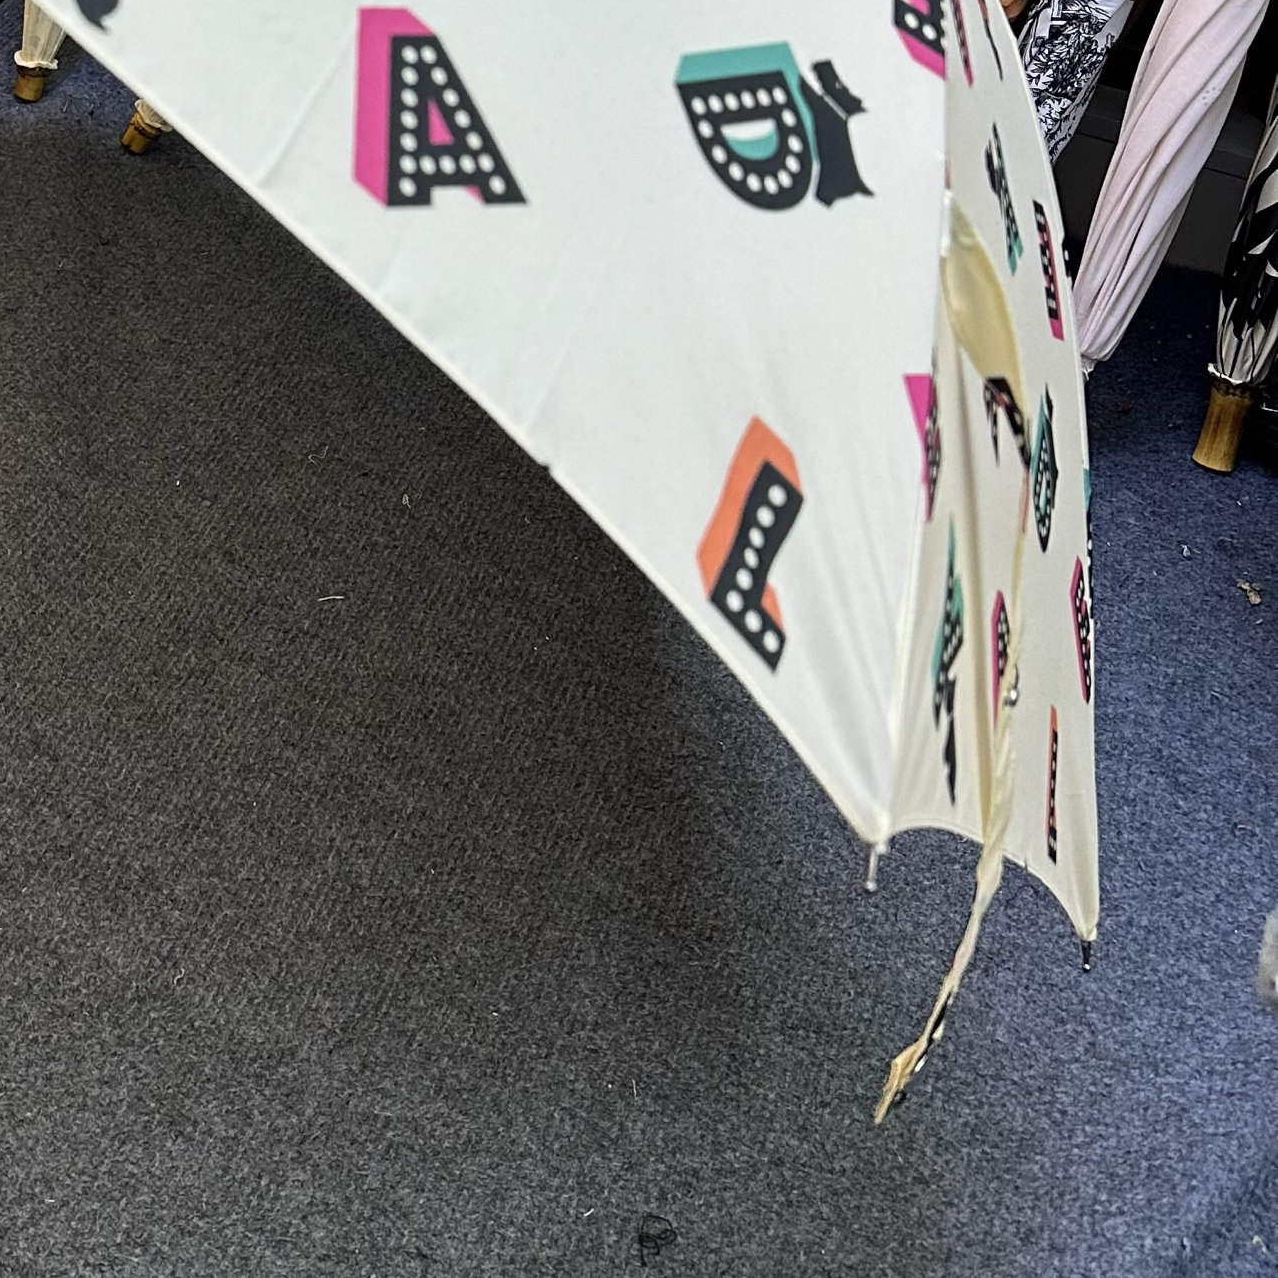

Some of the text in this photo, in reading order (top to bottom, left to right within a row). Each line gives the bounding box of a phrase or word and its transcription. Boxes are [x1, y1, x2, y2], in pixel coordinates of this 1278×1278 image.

[352, 6, 530, 208] A
[674, 41, 819, 211] D
[696, 414, 805, 673] L
